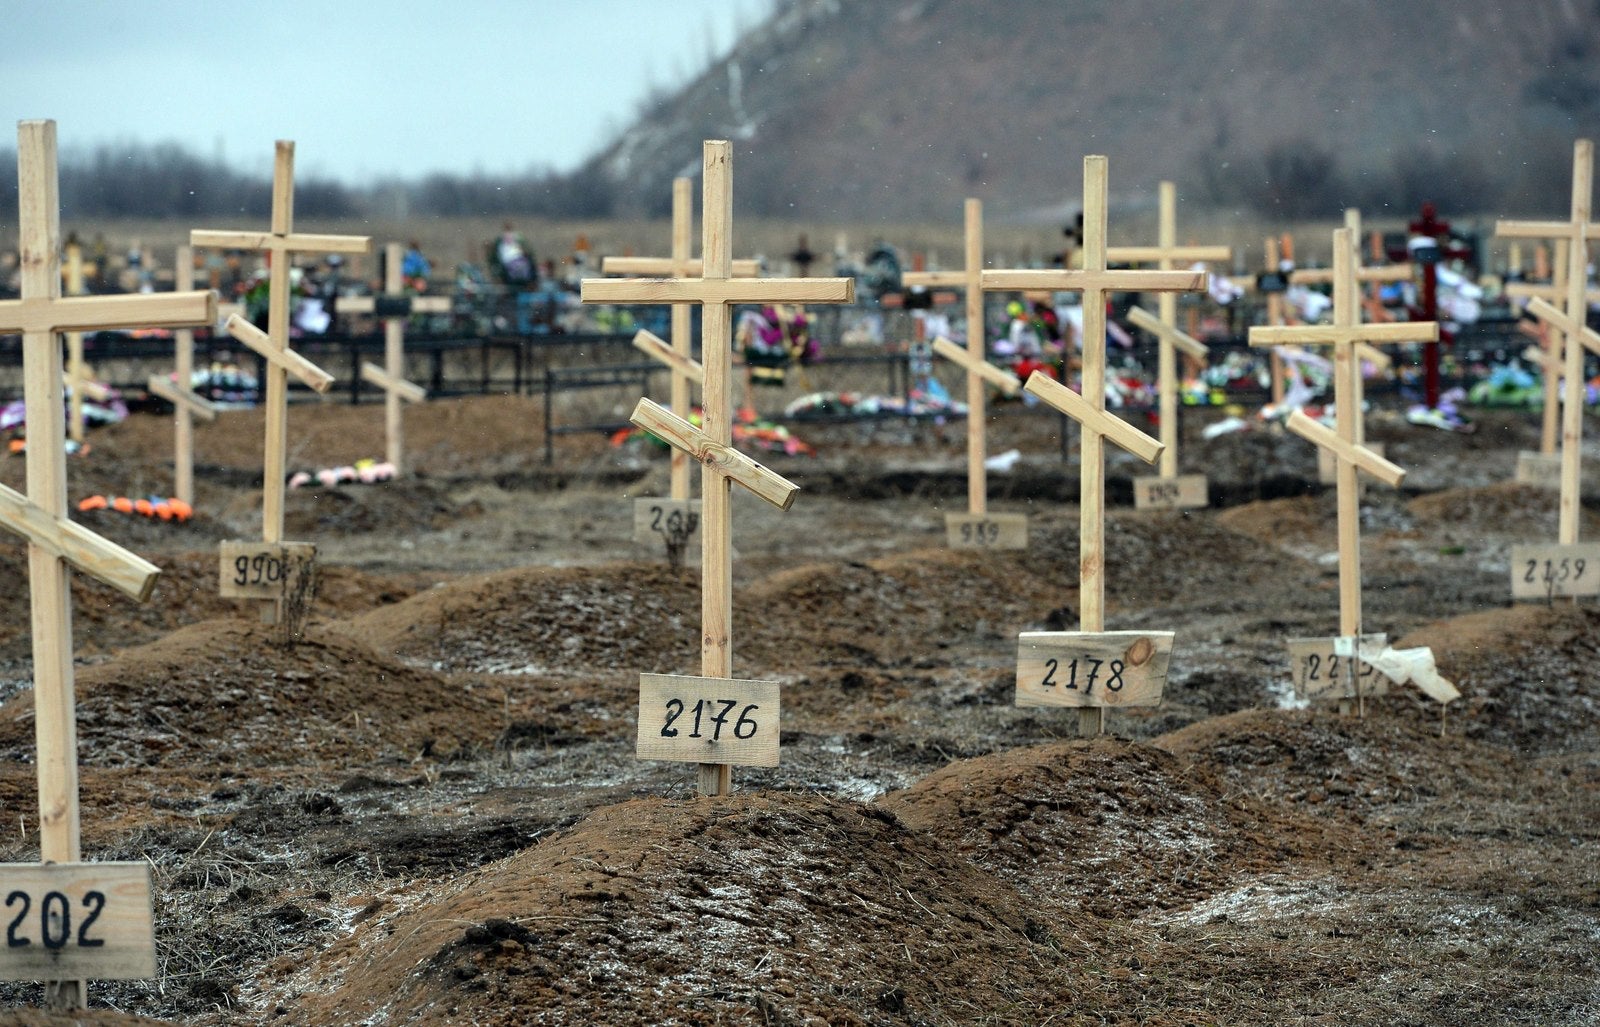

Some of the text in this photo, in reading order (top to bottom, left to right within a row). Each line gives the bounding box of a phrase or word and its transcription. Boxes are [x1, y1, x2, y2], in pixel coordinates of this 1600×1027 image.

[233, 554, 281, 586] 990
[1524, 558, 1586, 583] 2159
[1042, 657, 1125, 694] 2178
[661, 698, 759, 741] 2176
[5, 890, 106, 949] 202
